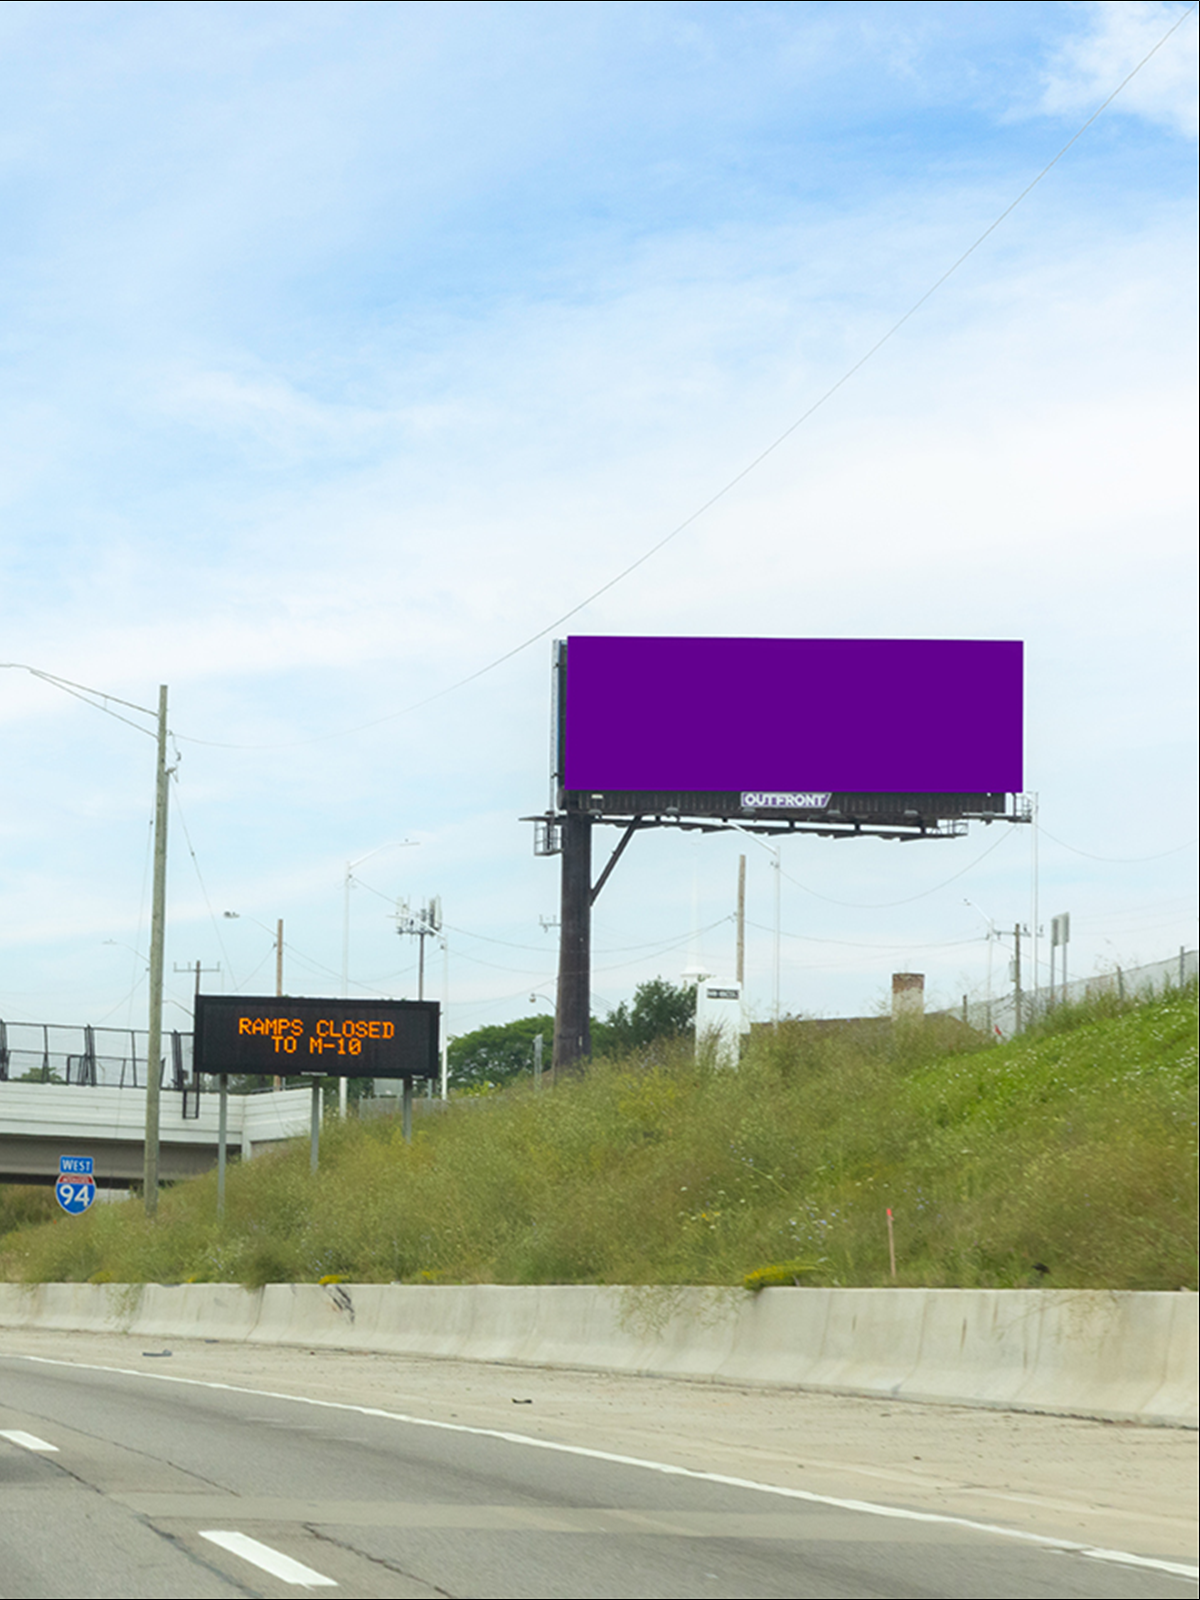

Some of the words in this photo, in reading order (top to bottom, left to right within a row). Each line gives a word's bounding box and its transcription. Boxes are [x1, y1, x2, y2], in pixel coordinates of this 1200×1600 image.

[744, 793, 827, 806] OUTFRONT
[238, 1017, 304, 1036] RAMPS
[316, 1019, 395, 1039] CLOSED
[271, 1035, 298, 1054] TO
[309, 1037, 362, 1056] M-10
[62, 1159, 91, 1172] WEST
[59, 1184, 90, 1207] 94
